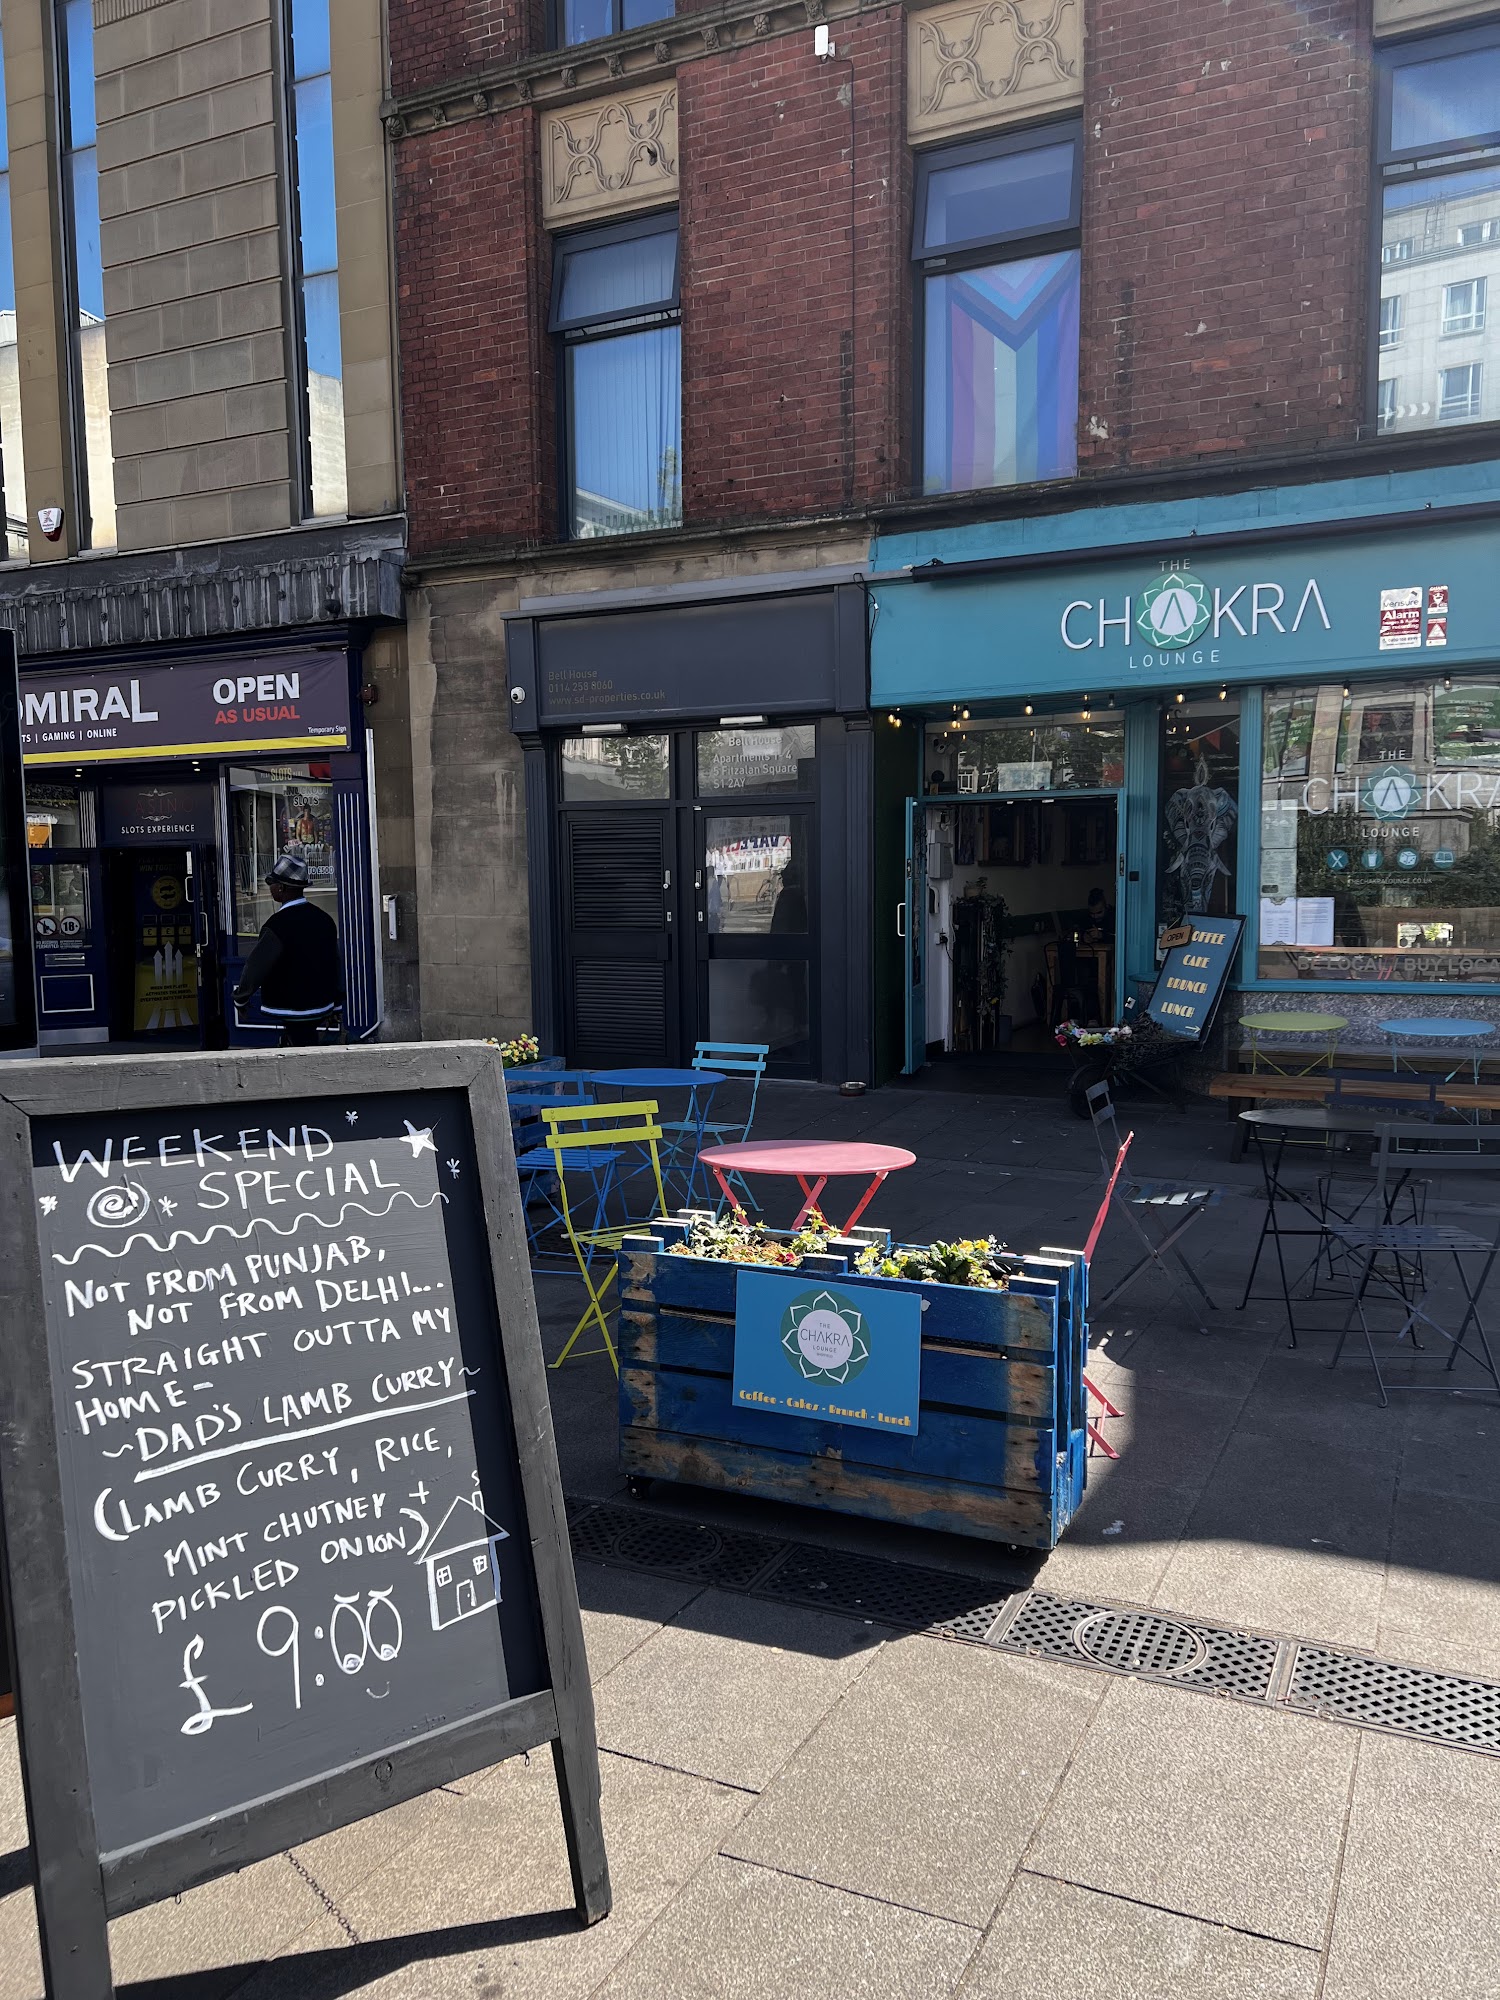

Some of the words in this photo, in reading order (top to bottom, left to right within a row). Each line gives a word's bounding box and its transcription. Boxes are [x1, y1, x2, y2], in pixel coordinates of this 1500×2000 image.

[1159, 558, 1192, 572] THE
[1060, 578, 1332, 650] CHAKRA
[1383, 609, 1419, 621] Alarm
[1129, 649, 1221, 669] LOUNGE
[548, 670, 567, 681] Bell
[569, 669, 598, 680] House
[548, 683, 570, 693] 0114
[572, 681, 589, 692] 258
[590, 679, 613, 690] 8060
[19, 679, 159, 725] MIRAL
[212, 672, 300, 705] OPEN
[548, 690, 666, 704] www.sd-properties.co.uk
[214, 709, 237, 725] AS
[243, 705, 300, 722] USUAL
[42, 730, 75, 742] GAMING
[87, 728, 117, 739] ONLINE
[308, 726, 334, 735] Temporary
[335, 725, 347, 733] Sign
[728, 736, 747, 747] Bell
[751, 735, 782, 746] House
[713, 752, 770, 764] Apartments
[1379, 749, 1407, 761] THE
[270, 767, 292, 782] SLOTS
[713, 766, 719, 776] 5
[722, 765, 760, 776] Fitzalan
[762, 763, 798, 776] Square
[713, 778, 725, 788] S1
[728, 777, 746, 788] 2AY
[293, 795, 319, 806] SLOTS
[121, 825, 144, 834] SLOTS
[147, 824, 195, 834] EXPERIENCE
[1362, 827, 1420, 838] LOUNGE
[1167, 931, 1185, 943] OPEN
[1191, 930, 1227, 946] OFFEE
[1182, 954, 1211, 969] CAKE
[1298, 958, 1322, 971] BE
[1327, 957, 1388, 971] LOCAL
[1404, 957, 1443, 972] BUY
[1166, 976, 1209, 995] BRUNCH
[1160, 1001, 1195, 1018] LUNCH
[52, 1124, 335, 1184] WEEKEND
[197, 1158, 402, 1211] SPECIAL
[64, 1278, 131, 1318] NOT
[146, 1262, 237, 1298] FROM
[245, 1236, 386, 1285] PUNJAB,
[127, 1301, 193, 1337] NOT
[219, 1285, 304, 1320] FROM
[819, 1322, 831, 1330] THE
[800, 1328, 850, 1347] CHAKRA
[71, 1332, 268, 1391] STRAIGHT
[293, 1317, 402, 1352] OUTTA
[411, 1306, 451, 1336] MY
[812, 1344, 837, 1354] LOUNGE
[263, 1382, 353, 1428] LAMB
[739, 1389, 777, 1405] Coffee
[786, 1397, 820, 1411] Cakes
[828, 1404, 868, 1420] Brunch
[878, 1412, 912, 1427] Lunch
[236, 1446, 358, 1496] CURRY,
[375, 1427, 453, 1473] RICE,
[163, 1531, 248, 1577] MINT
[263, 1492, 386, 1543] CHUTNEY
[151, 1558, 300, 1634] PICKLED
